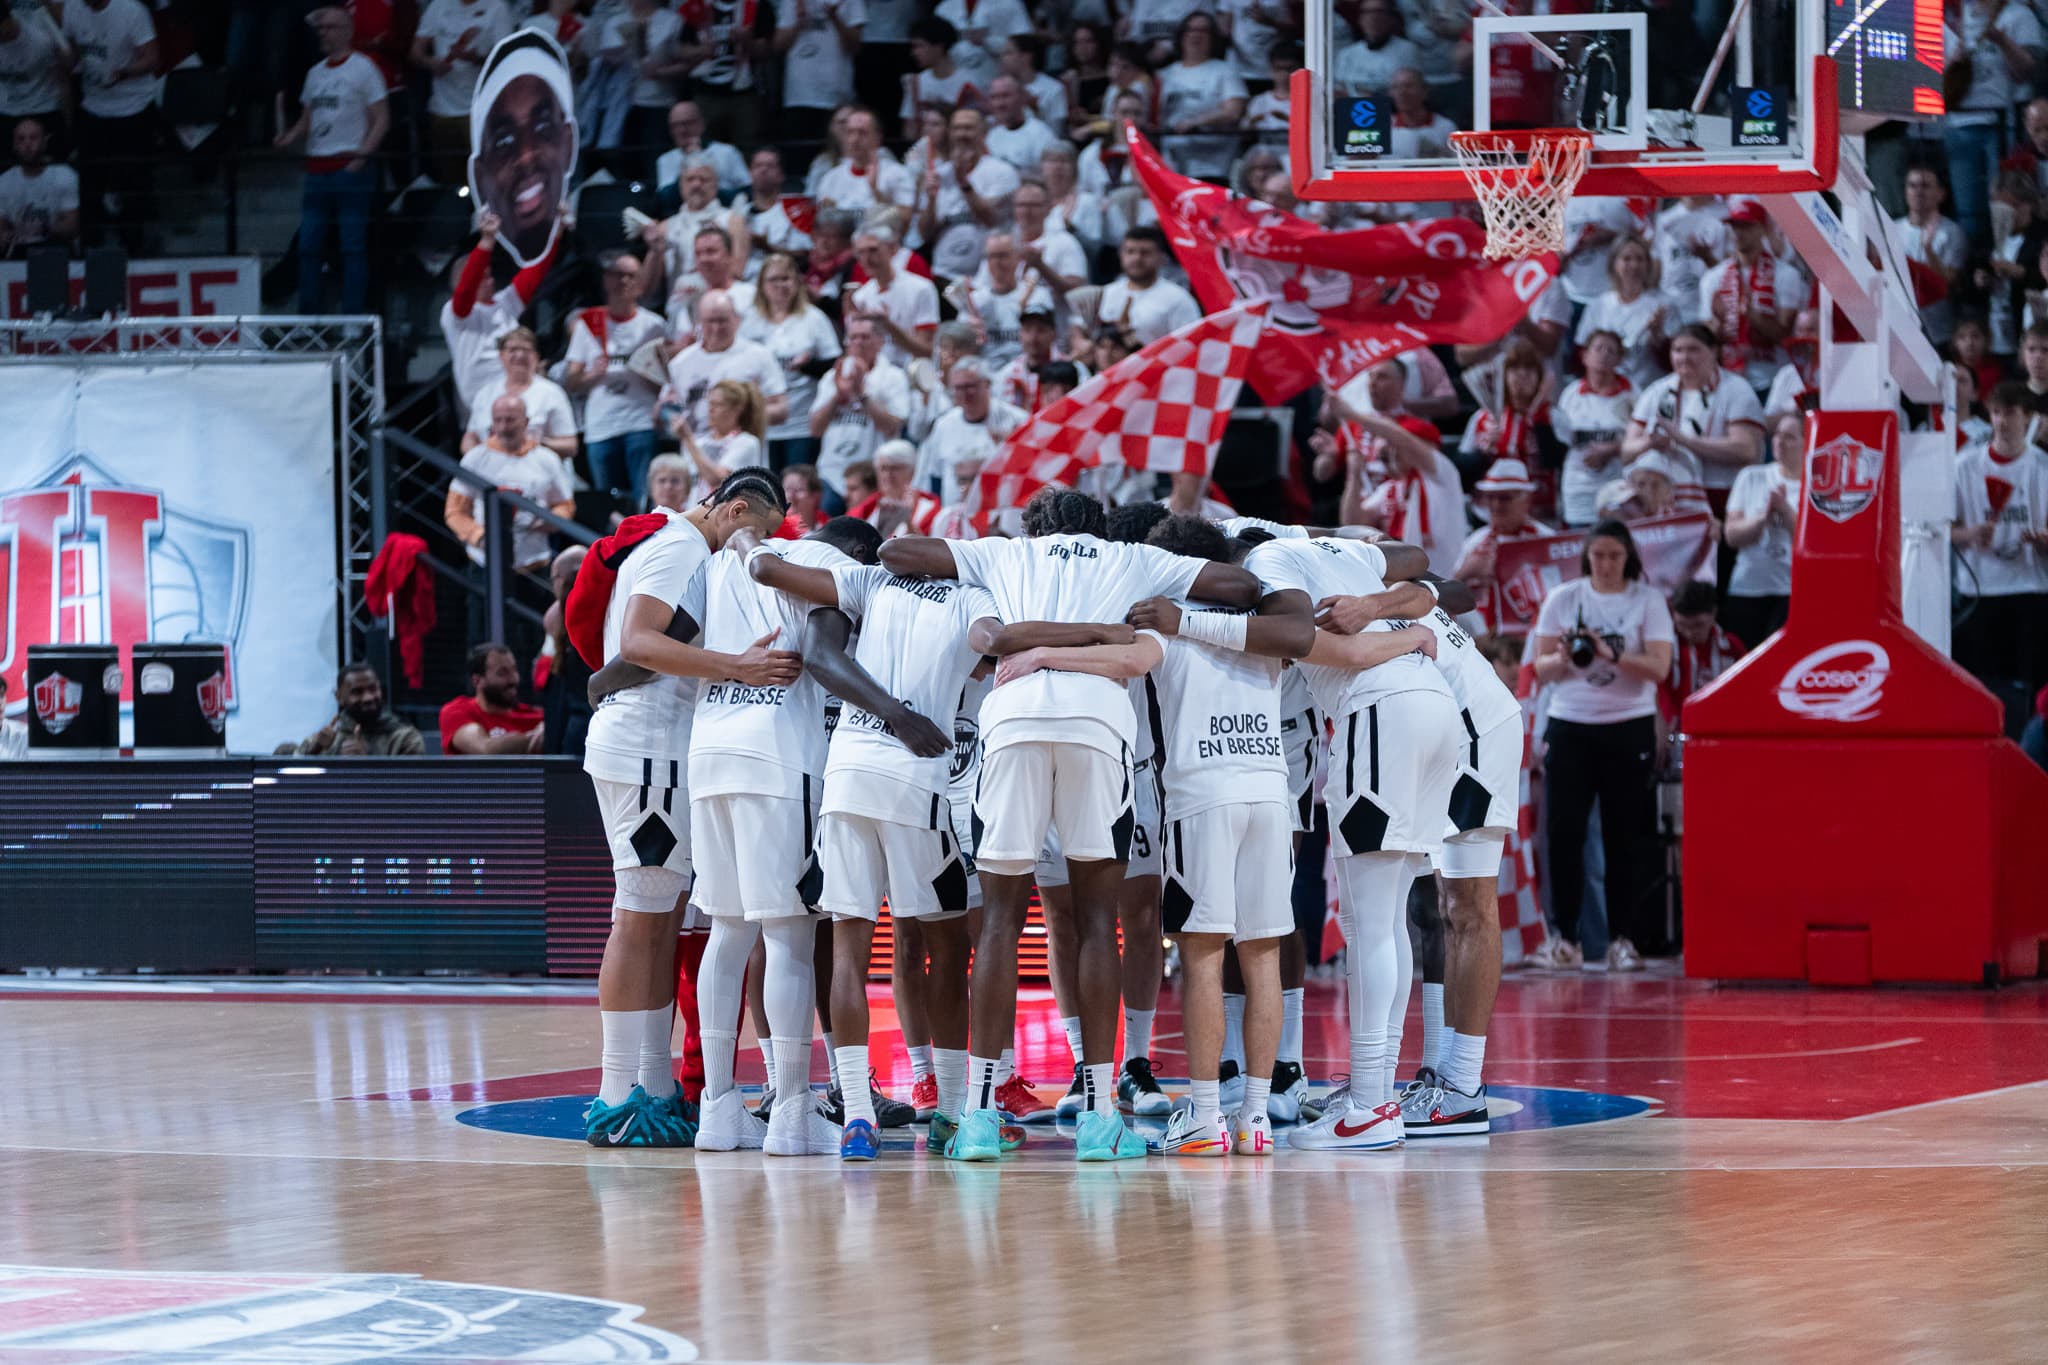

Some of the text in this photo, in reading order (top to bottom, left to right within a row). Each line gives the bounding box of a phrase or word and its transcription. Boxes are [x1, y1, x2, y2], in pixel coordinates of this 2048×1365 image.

[1343, 143, 1385, 154] EuroCup
[706, 685, 786, 706] EN BRESSE
[1210, 713, 1268, 737] BOURG
[1198, 736, 1281, 759] EN BRESSE
